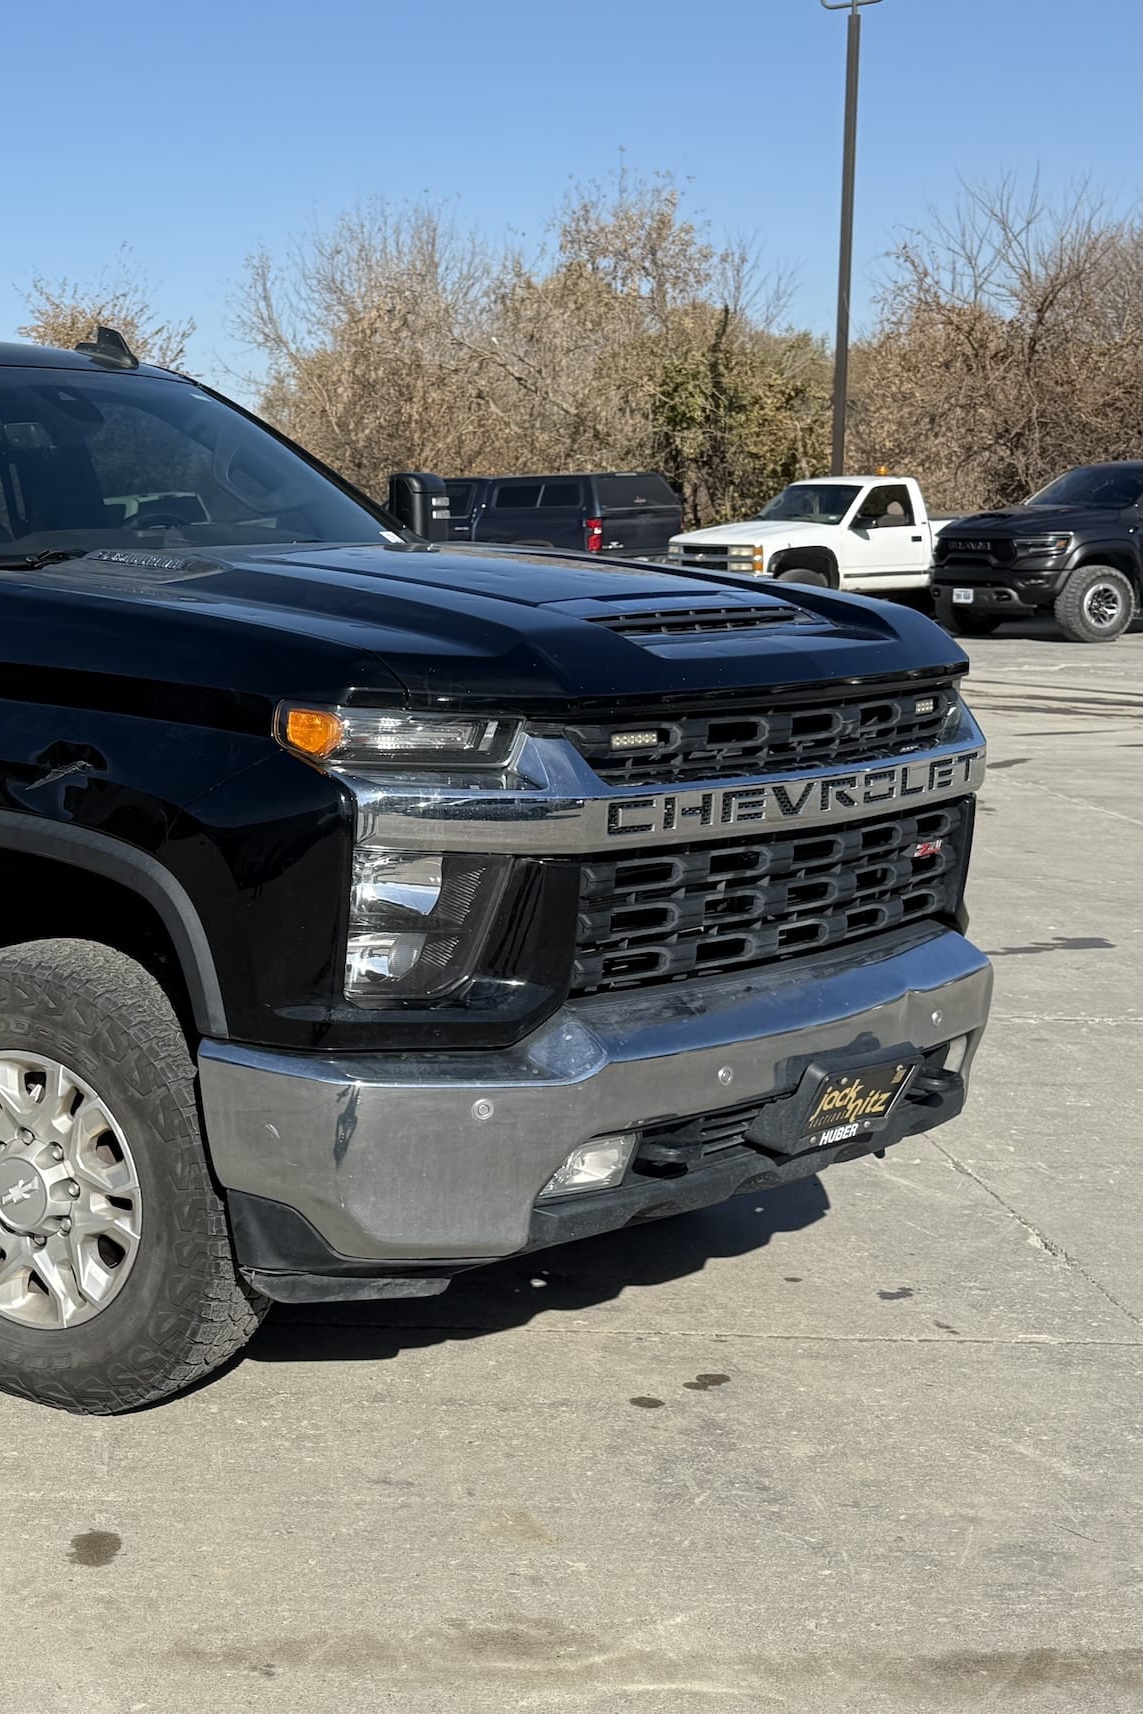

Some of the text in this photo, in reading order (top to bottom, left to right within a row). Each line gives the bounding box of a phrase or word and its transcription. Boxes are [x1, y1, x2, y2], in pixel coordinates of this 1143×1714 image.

[607, 753, 980, 835] CHEVROLET
[809, 1079, 864, 1122] jack
[845, 1090, 892, 1123] nitz
[819, 1123, 859, 1146] HUBER
